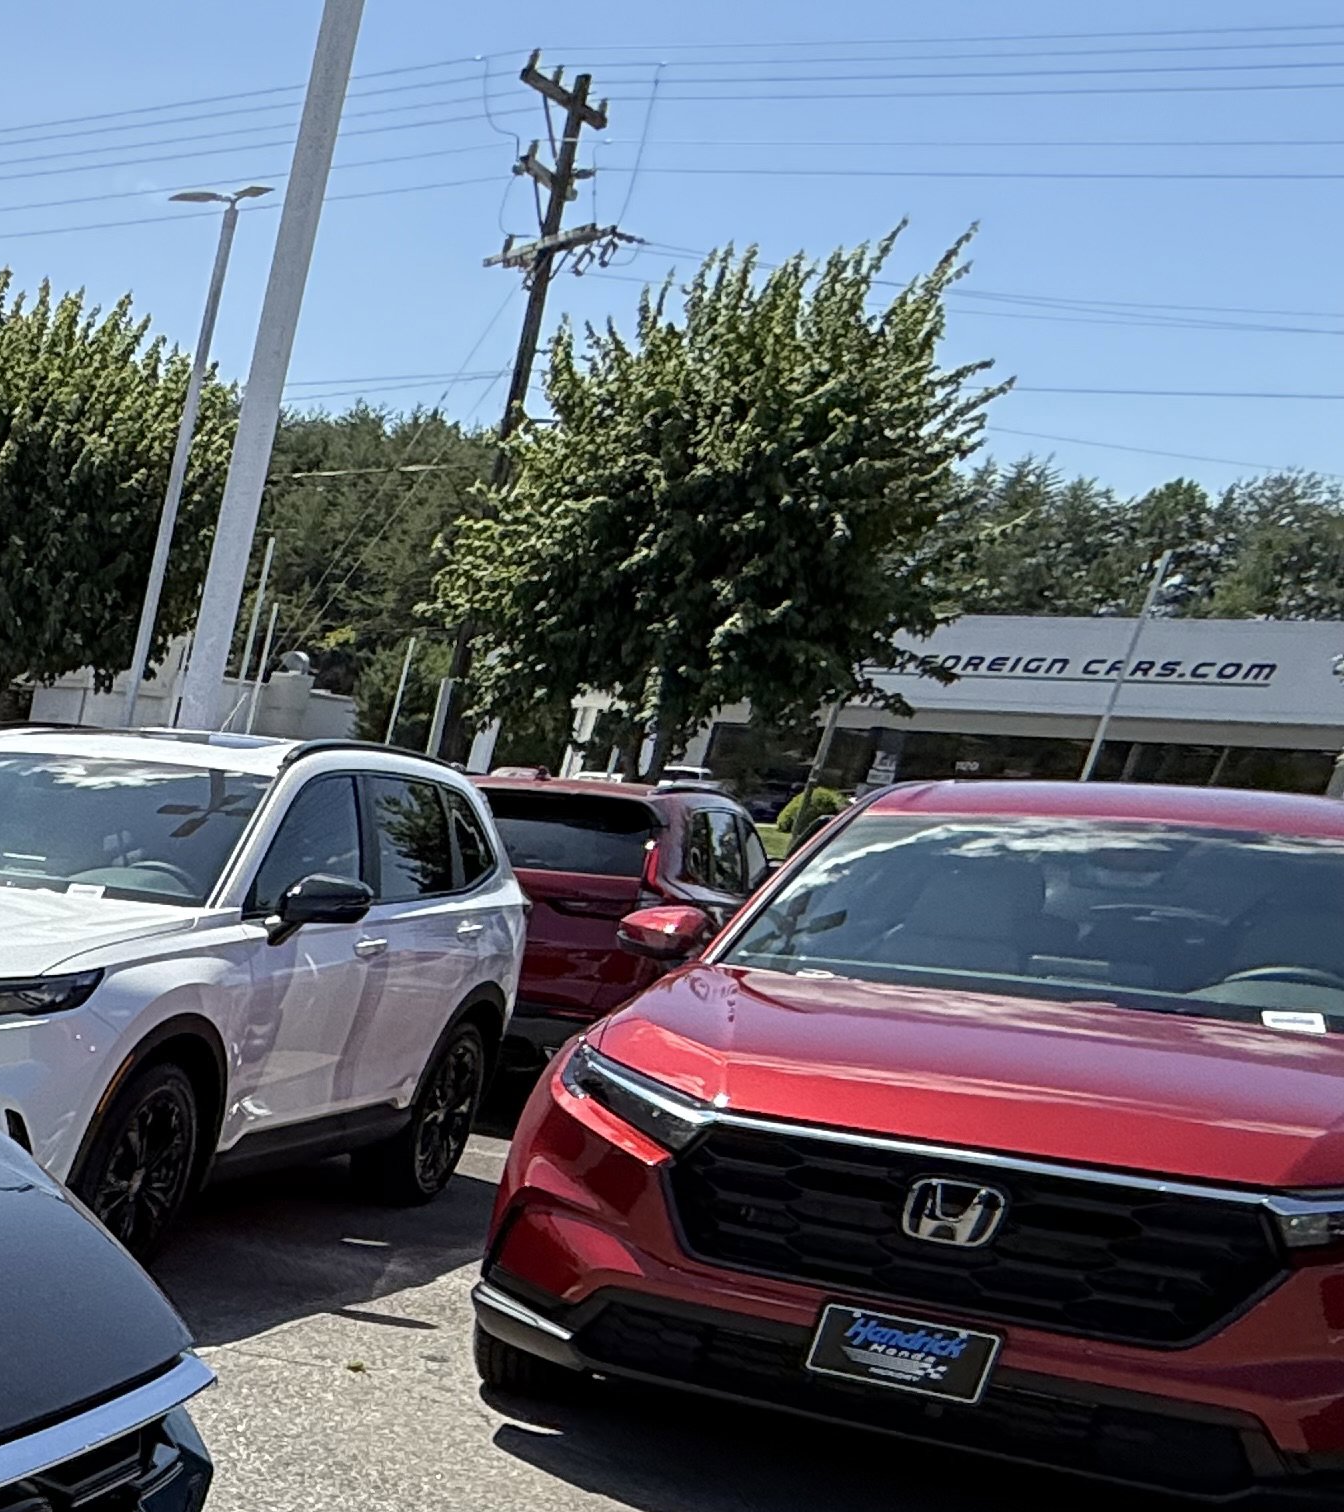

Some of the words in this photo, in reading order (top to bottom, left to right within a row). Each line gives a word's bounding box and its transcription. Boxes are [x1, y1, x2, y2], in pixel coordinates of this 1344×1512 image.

[915, 654, 1070, 675] FOREIGN
[843, 1317, 968, 1359] Hendrick
[869, 1342, 937, 1363] Honda
